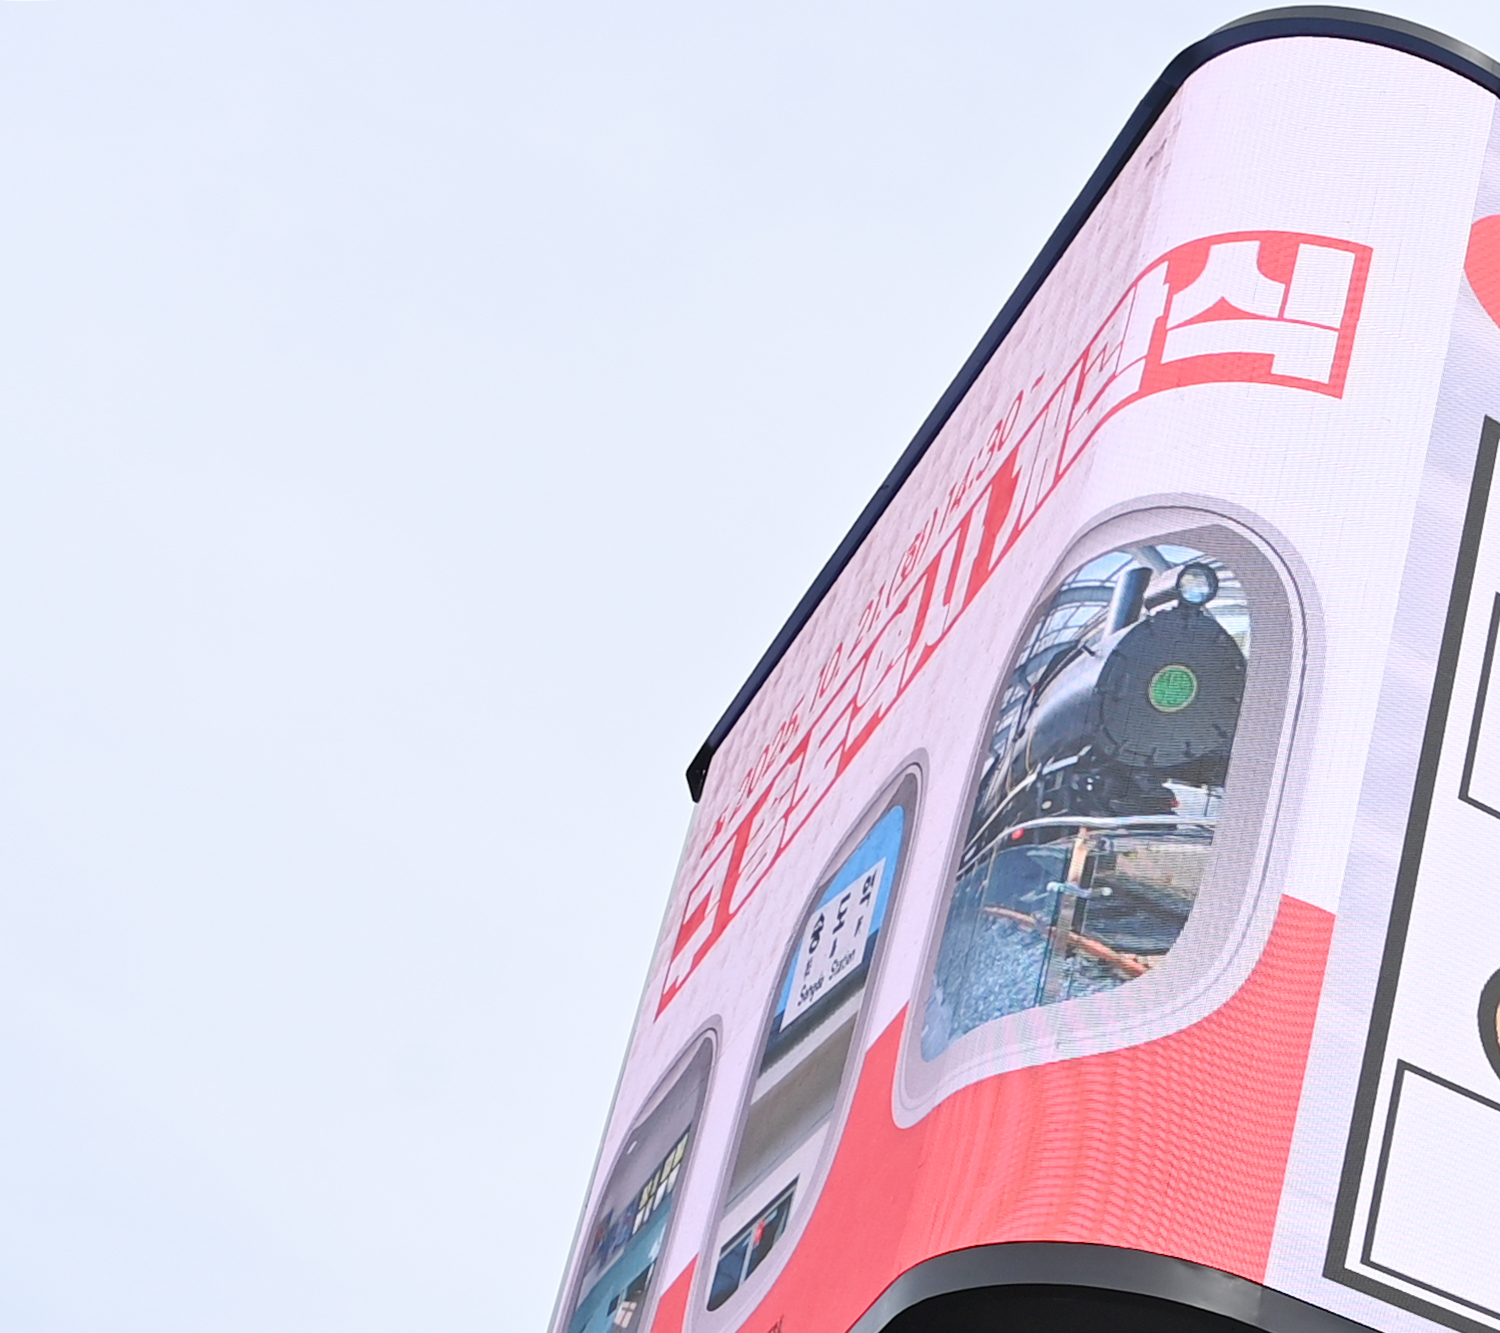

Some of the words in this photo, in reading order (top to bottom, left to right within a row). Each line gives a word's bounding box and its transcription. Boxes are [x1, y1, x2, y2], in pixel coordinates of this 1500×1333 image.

[657, 828, 739, 1014] 구
[728, 480, 996, 918] 송도역사
[988, 232, 1370, 574] 개관식
[728, 694, 806, 824] 2025.
